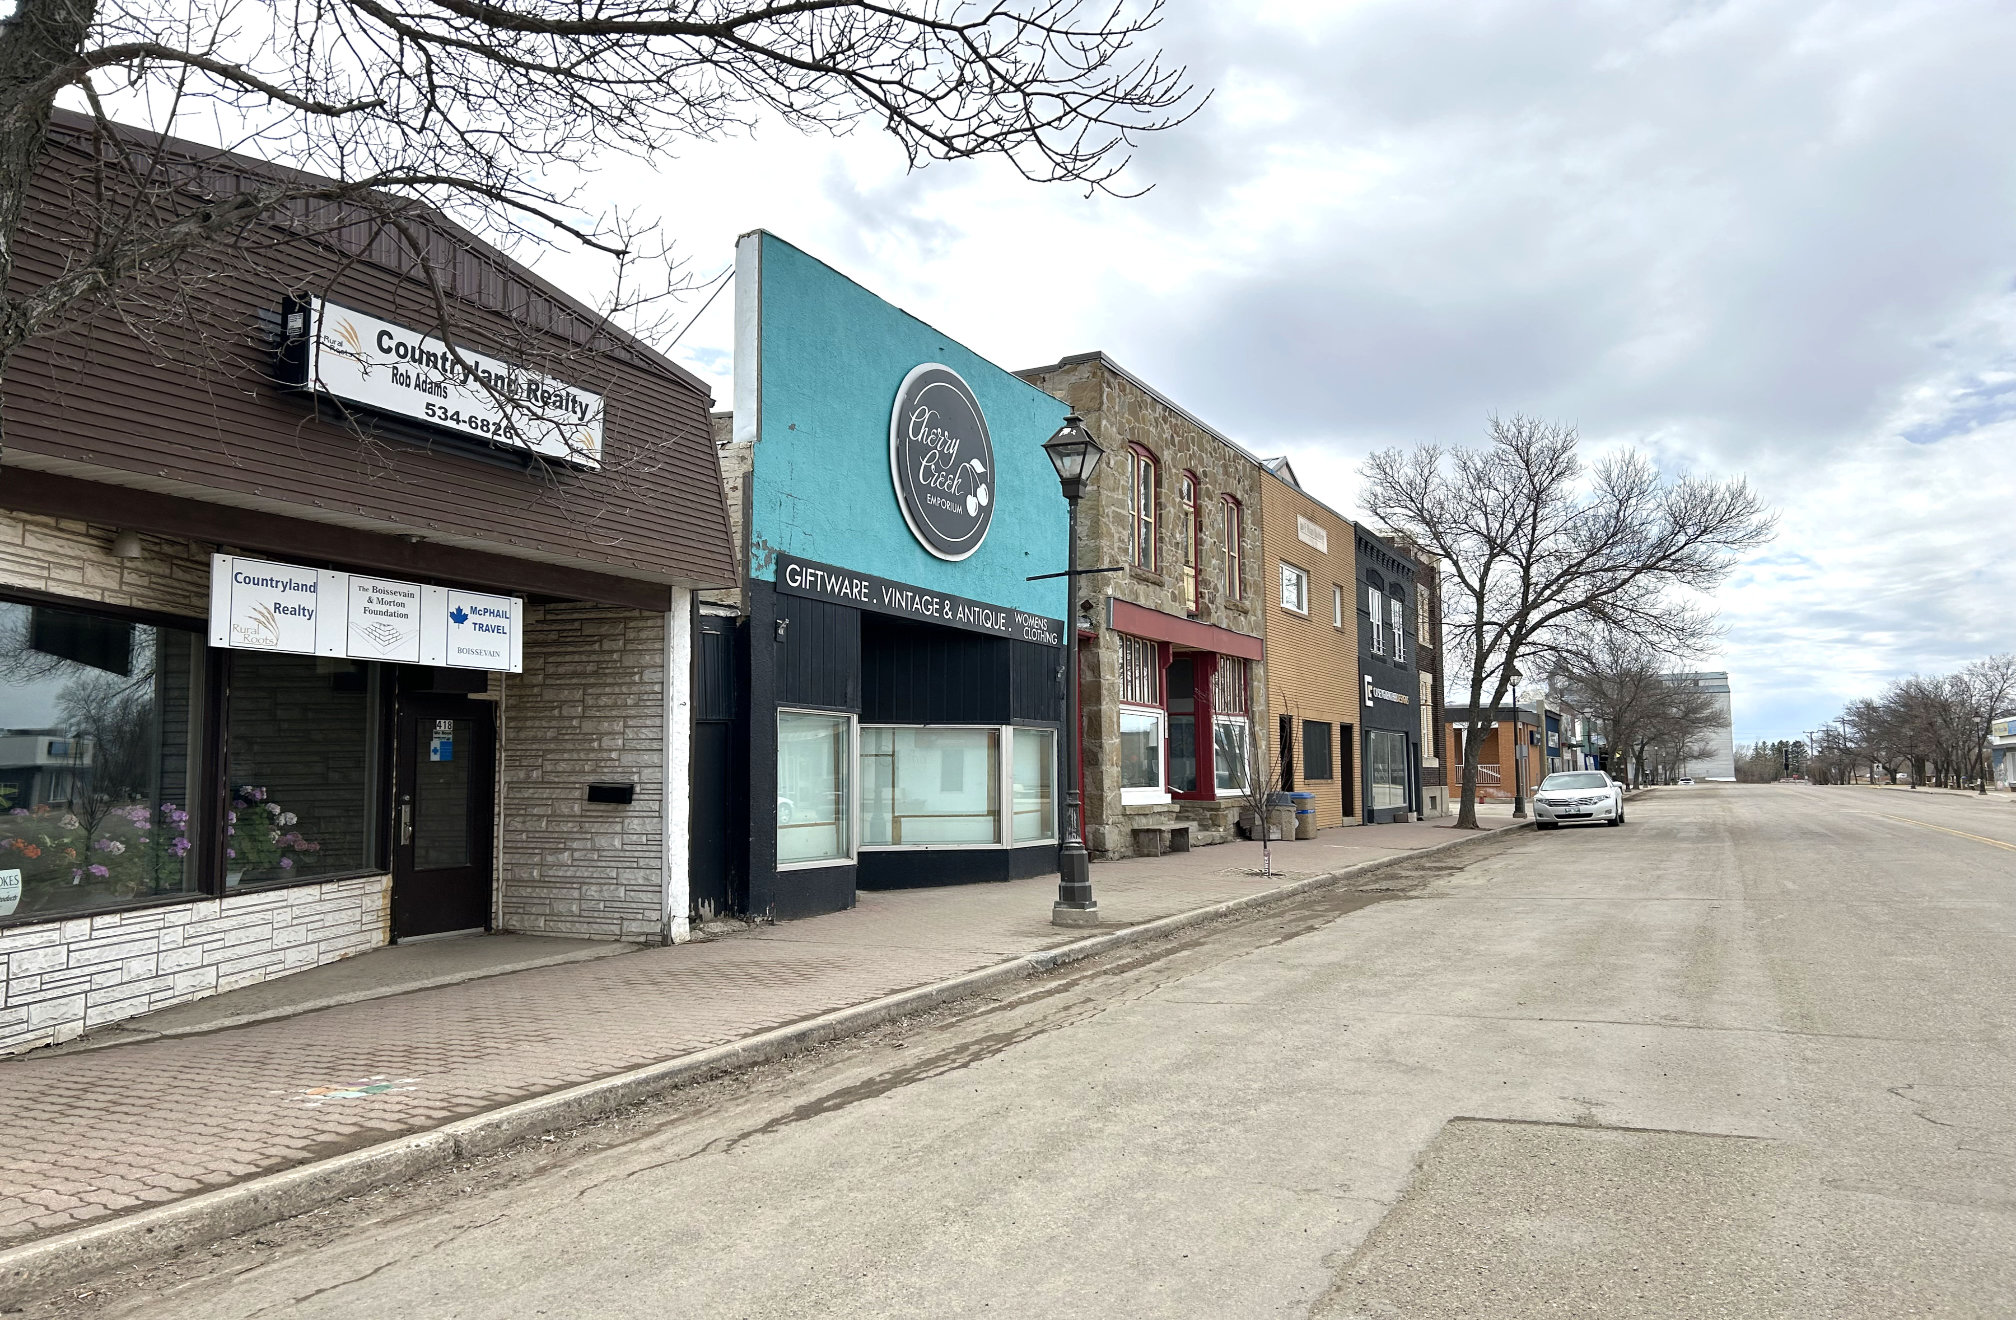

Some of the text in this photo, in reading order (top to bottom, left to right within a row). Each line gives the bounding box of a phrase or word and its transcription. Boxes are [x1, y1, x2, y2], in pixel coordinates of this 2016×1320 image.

[376, 329, 589, 421] Countryland Realty
[391, 365, 448, 399] Rob Adams
[425, 402, 514, 440] 534-6826
[909, 406, 960, 469] Cherry
[919, 450, 965, 495] Creek
[926, 494, 963, 515] EMPORIUM
[233, 571, 317, 594] Countryland
[357, 585, 415, 599] The Boissevain
[785, 564, 1006, 631] GIFTWARE VINTAGE & ANTIQUE
[366, 596, 406, 608] & Morton
[273, 602, 314, 621] Realty
[363, 606, 409, 620] Foundation
[469, 605, 510, 620] McPHAIL
[232, 623, 260, 635] Rural
[471, 621, 507, 635] TRAVEL
[1014, 611, 1048, 631] WOMENS
[242, 634, 274, 645] Roots
[1023, 627, 1058, 645] CLOTHING
[456, 646, 501, 658] BOISSEVAIN
[436, 720, 452, 730] 418
